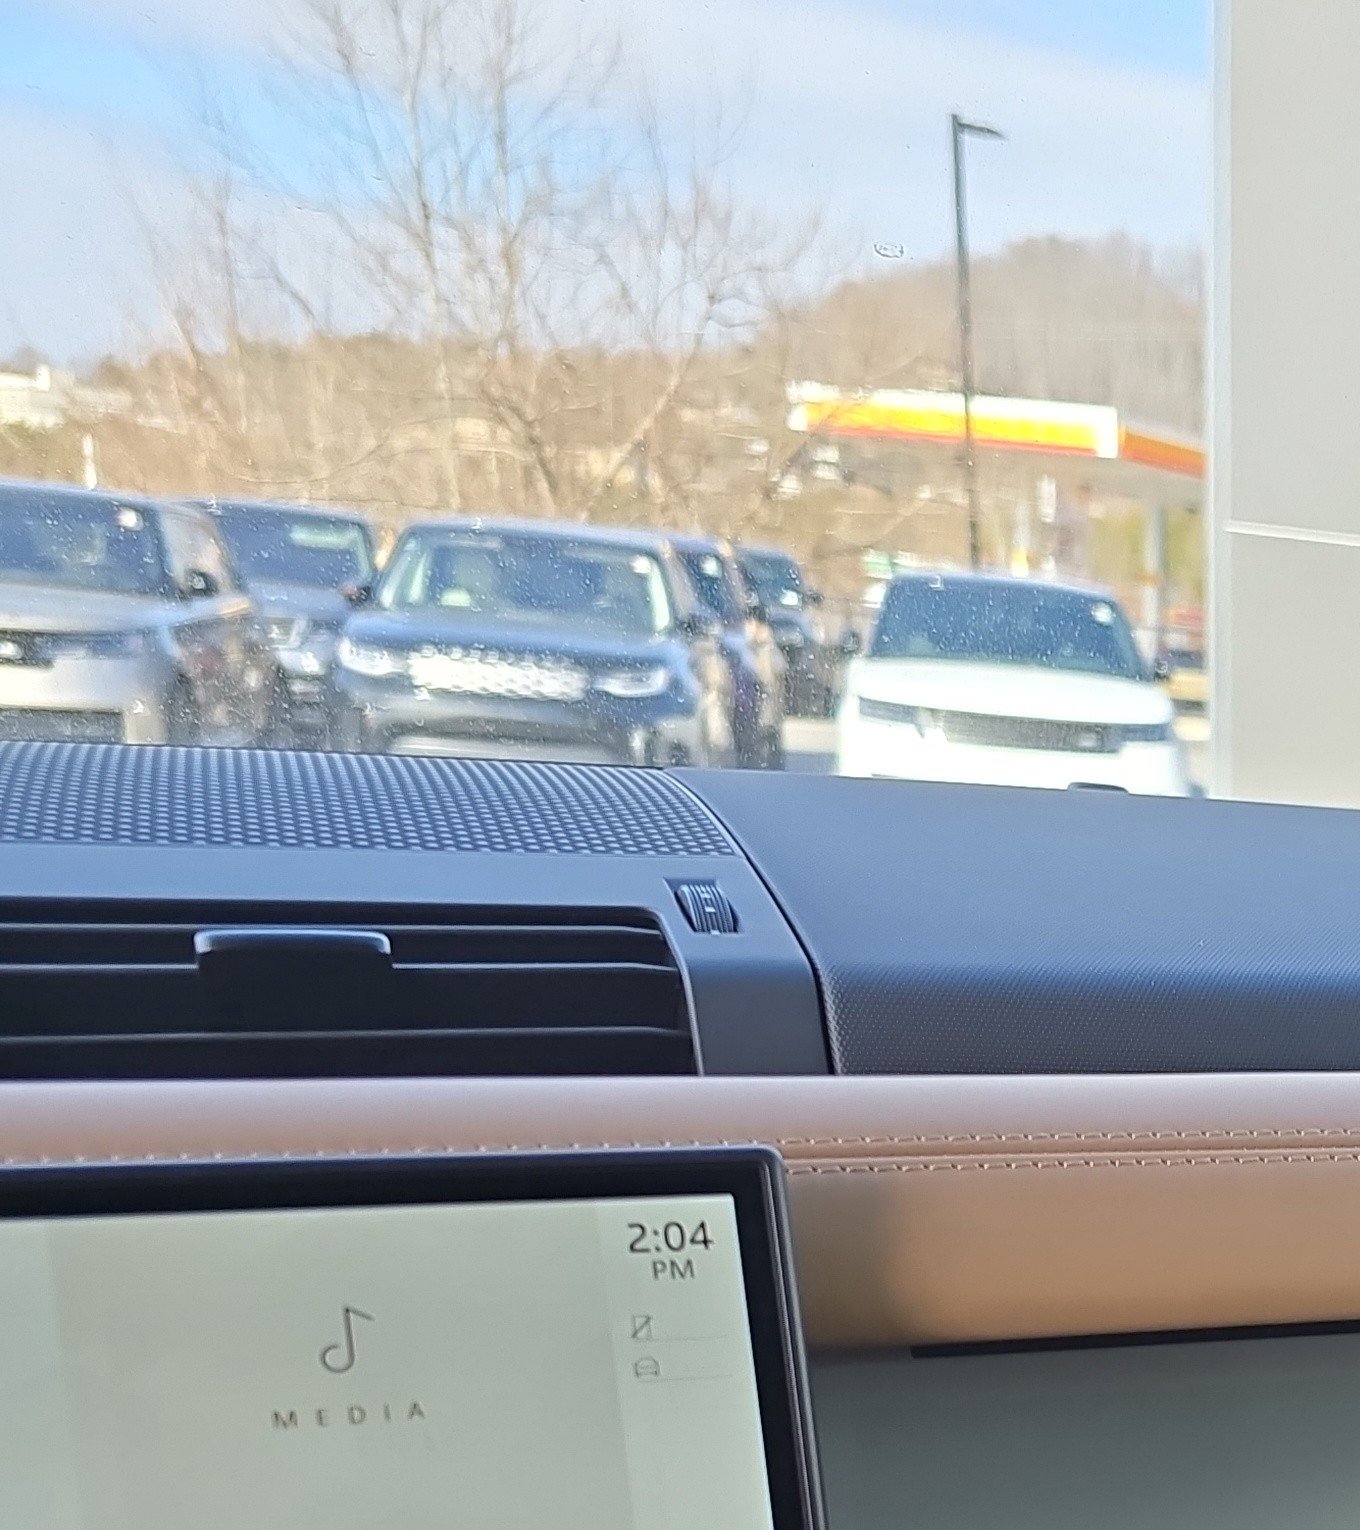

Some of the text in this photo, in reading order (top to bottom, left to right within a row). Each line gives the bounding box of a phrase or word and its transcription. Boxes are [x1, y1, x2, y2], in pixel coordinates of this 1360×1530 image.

[628, 1220, 715, 1254] 2:04
[651, 1258, 696, 1281] PM
[272, 1400, 426, 1431] MEDIA
